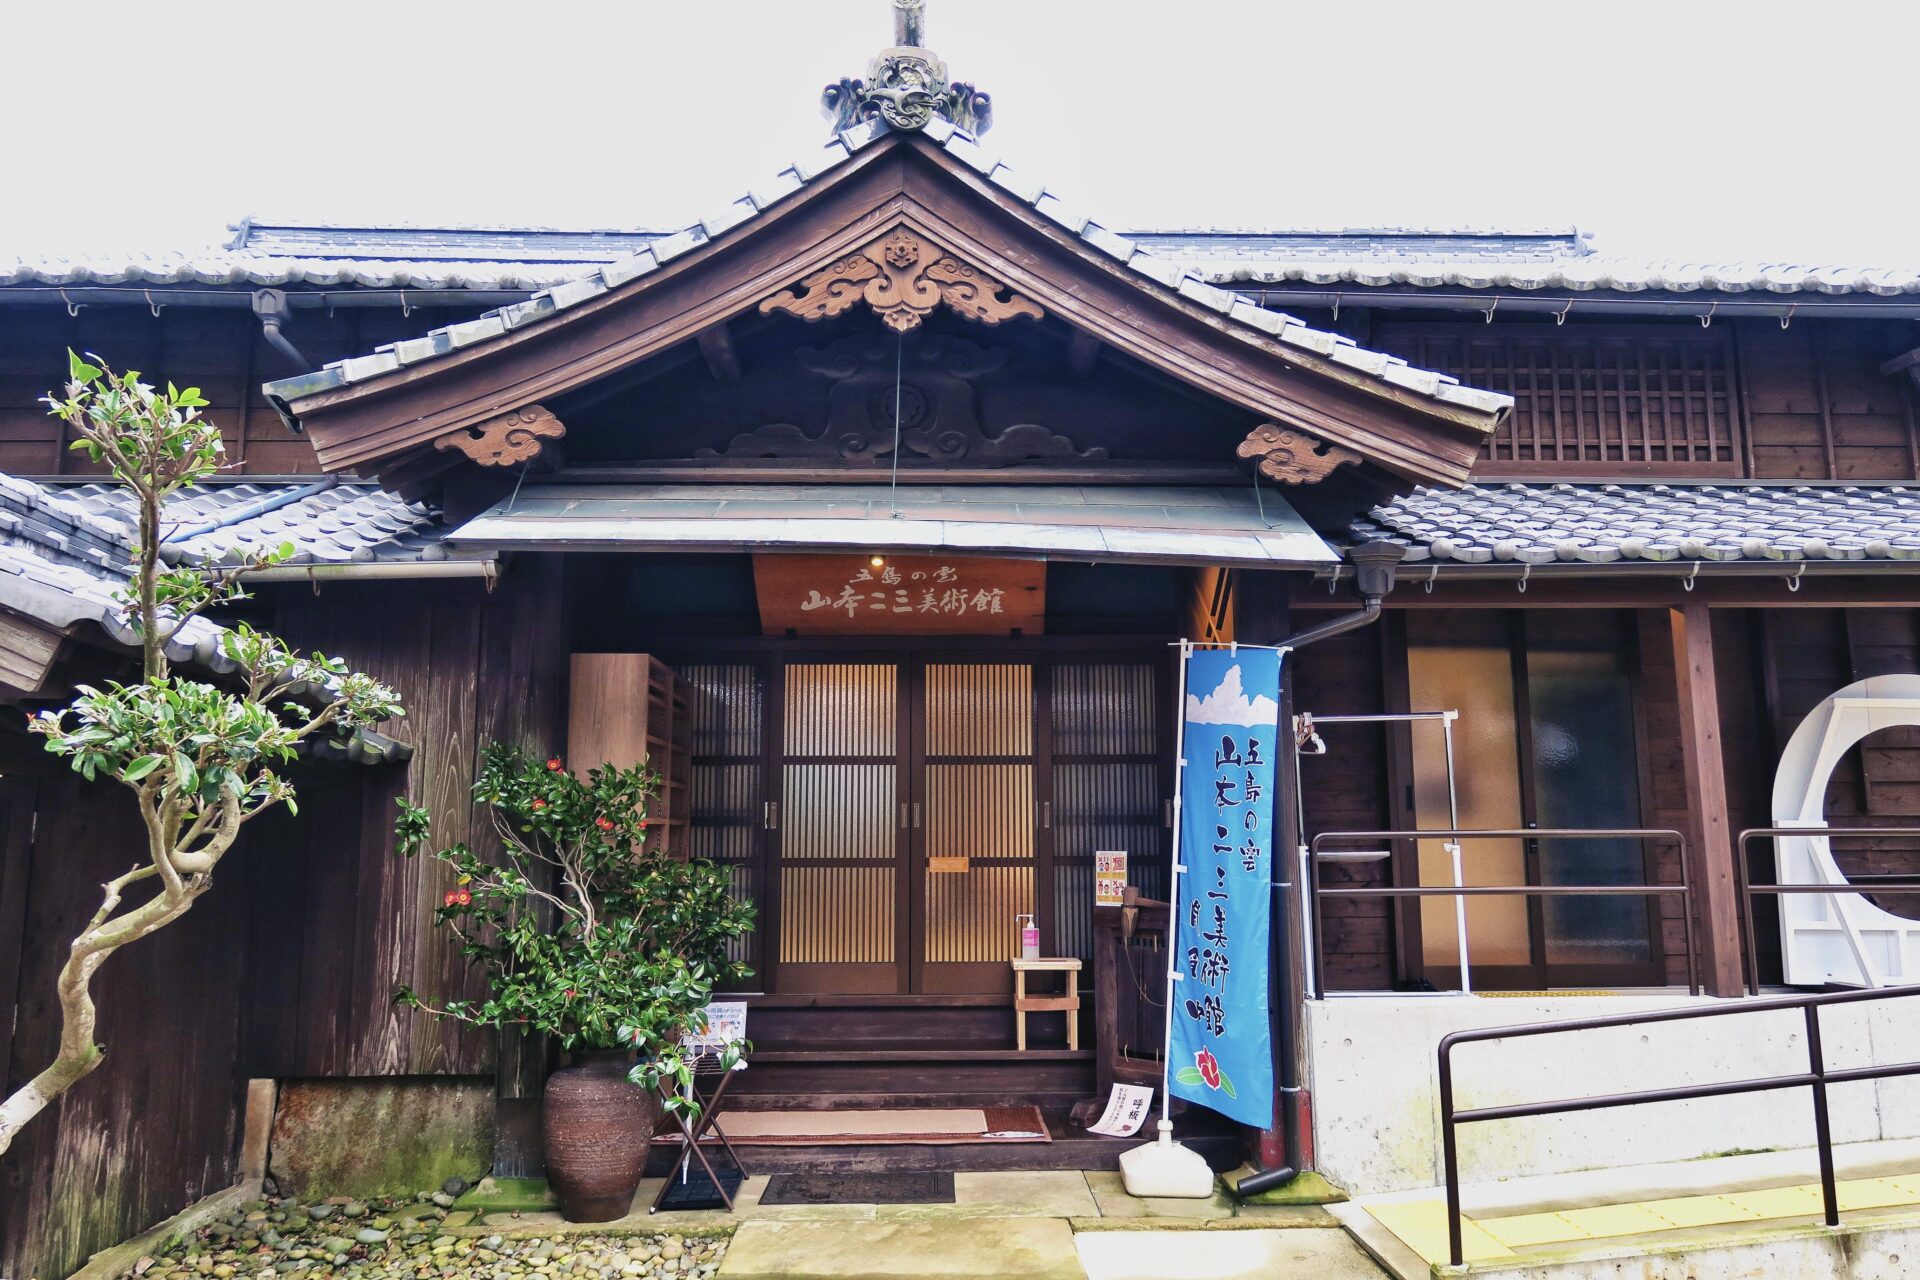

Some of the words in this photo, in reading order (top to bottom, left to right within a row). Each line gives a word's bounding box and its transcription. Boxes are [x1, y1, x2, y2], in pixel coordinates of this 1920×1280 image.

[801, 585, 1005, 618] 山本二三美術館
[850, 566, 957, 585] 五島の雲
[1240, 737, 1264, 872] 五島の雲
[1200, 735, 1242, 1038] 山本二三美術館
